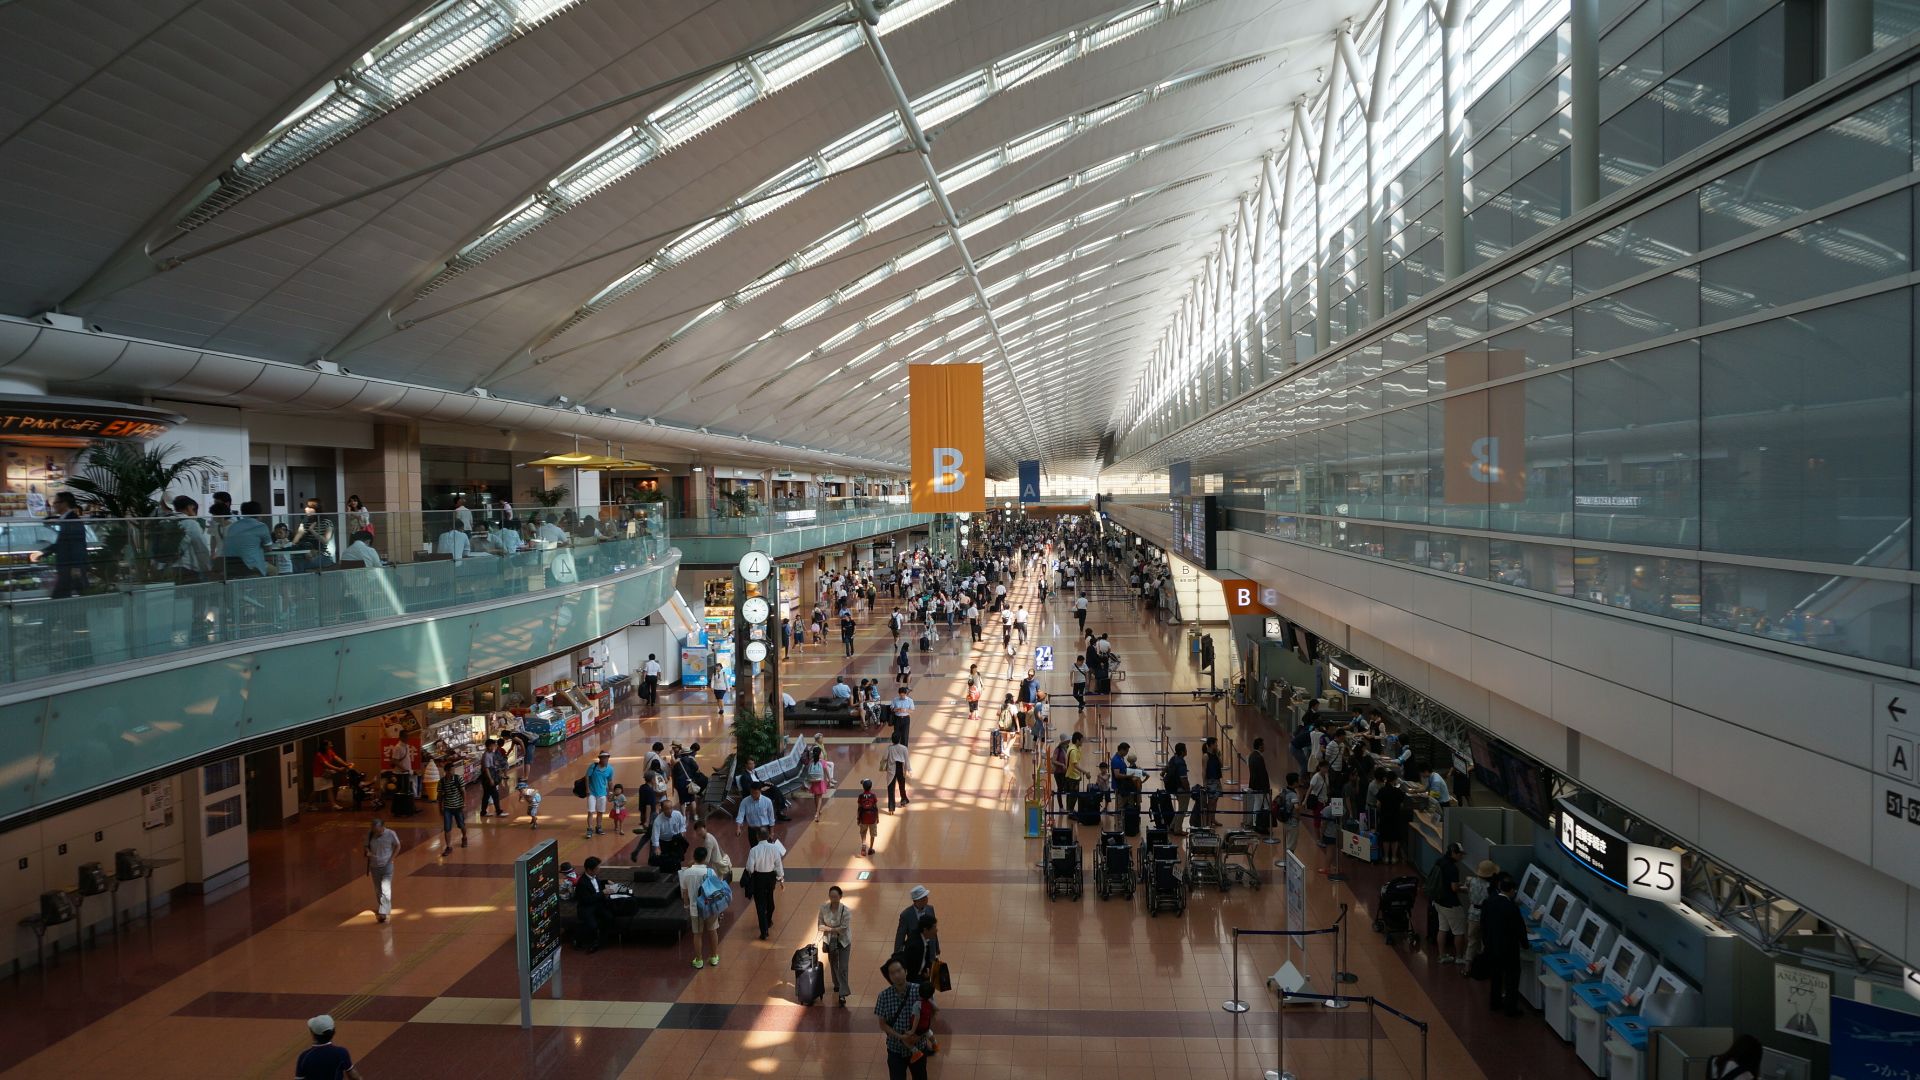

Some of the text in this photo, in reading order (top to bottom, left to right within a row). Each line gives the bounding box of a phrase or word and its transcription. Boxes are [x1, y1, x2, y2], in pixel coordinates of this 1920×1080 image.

[0, 416, 20, 429] T
[933, 447, 966, 493] B
[1023, 483, 1036, 498] A
[748, 557, 760, 577] 4
[1182, 565, 1190, 575] B
[1237, 588, 1251, 606] B
[1267, 622, 1280, 635] 23
[1036, 646, 1053, 661] 24
[1350, 686, 1360, 696] 24
[1892, 745, 1908, 771] A
[1633, 857, 1674, 890] 25
[1864, 1063, 1920, 1080] つかう
